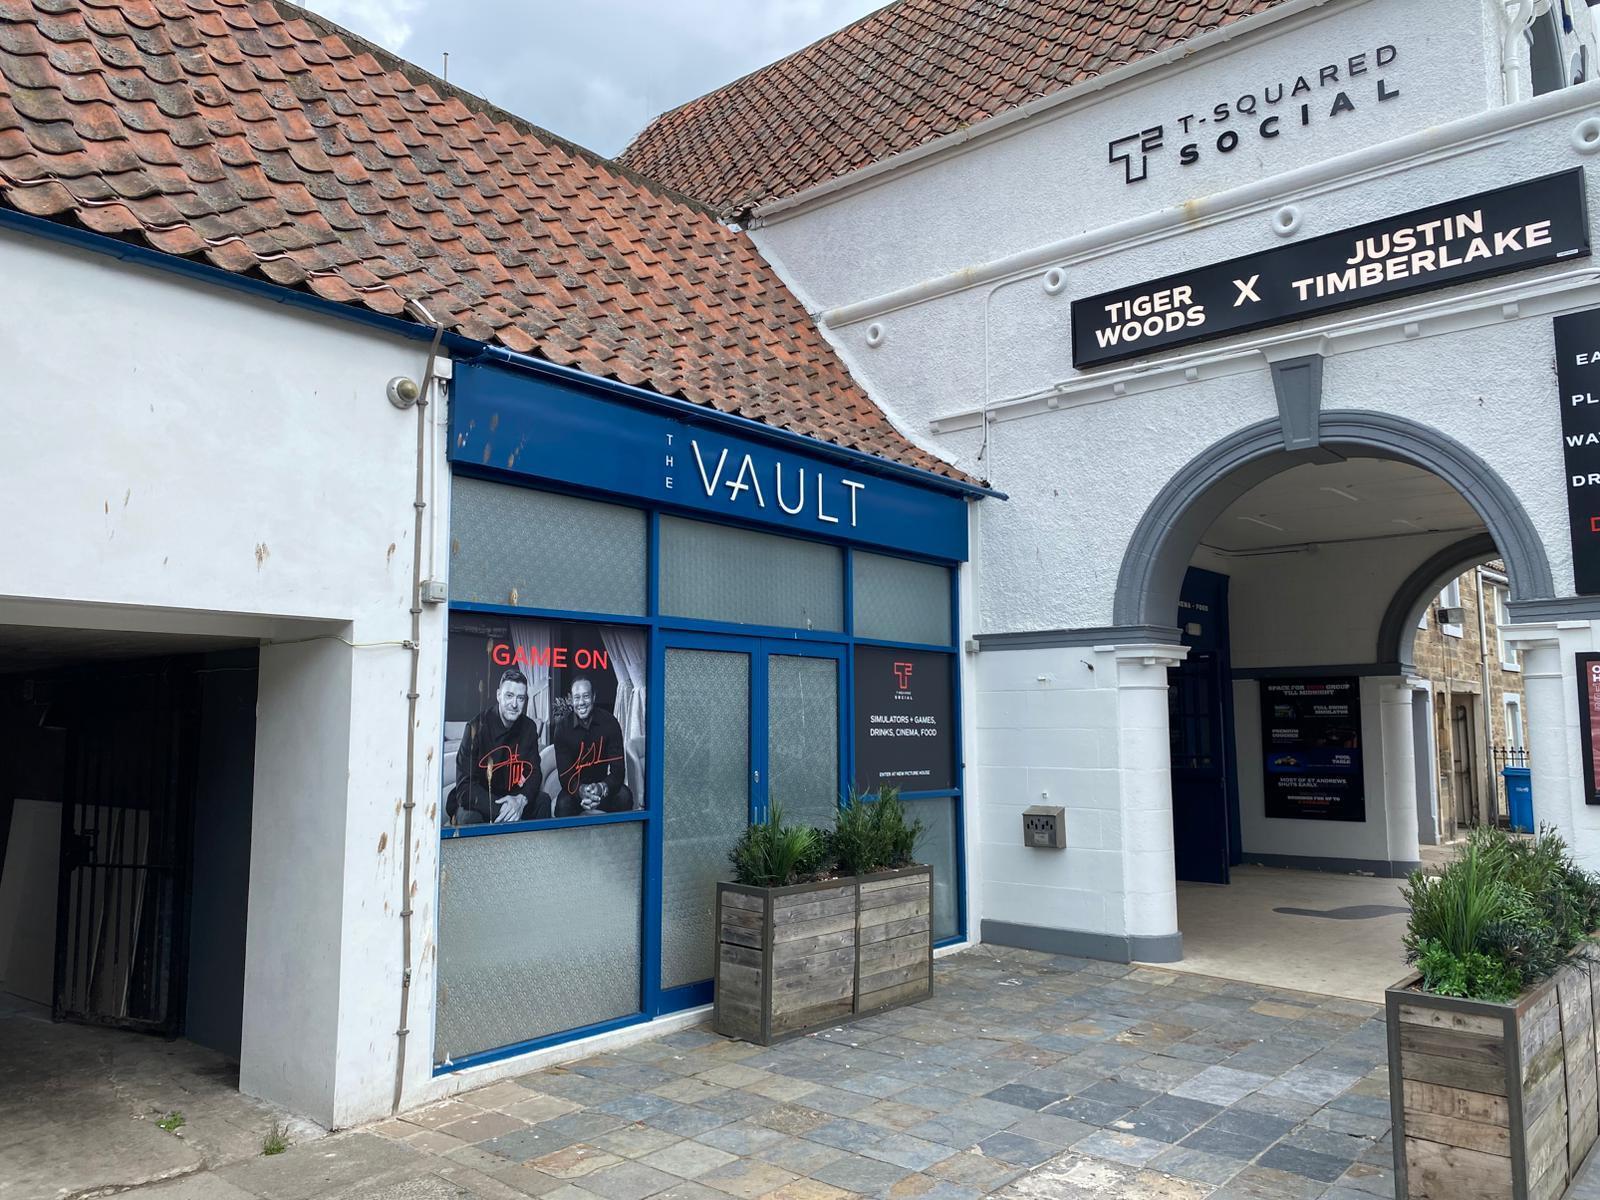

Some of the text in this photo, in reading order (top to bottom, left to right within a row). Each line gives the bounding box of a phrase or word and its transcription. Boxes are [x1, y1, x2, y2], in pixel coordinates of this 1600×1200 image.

[1178, 44, 1397, 133] T-SQUARED
[1180, 79, 1399, 165] SOCIAL
[1292, 220, 1552, 301] TIMBERLAKE
[1346, 209, 1484, 265] JUSTIN
[1095, 305, 1206, 348] WOODS
[1105, 274, 1262, 325] TIGER X
[665, 433, 674, 489] THE
[691, 440, 866, 528] VAULT
[492, 643, 608, 670] GAME ON
[870, 715, 909, 724] SIMULATORS
[914, 715, 936, 725] GAMES,
[870, 728, 937, 738] DRINKS, CINEMA, FOOD
